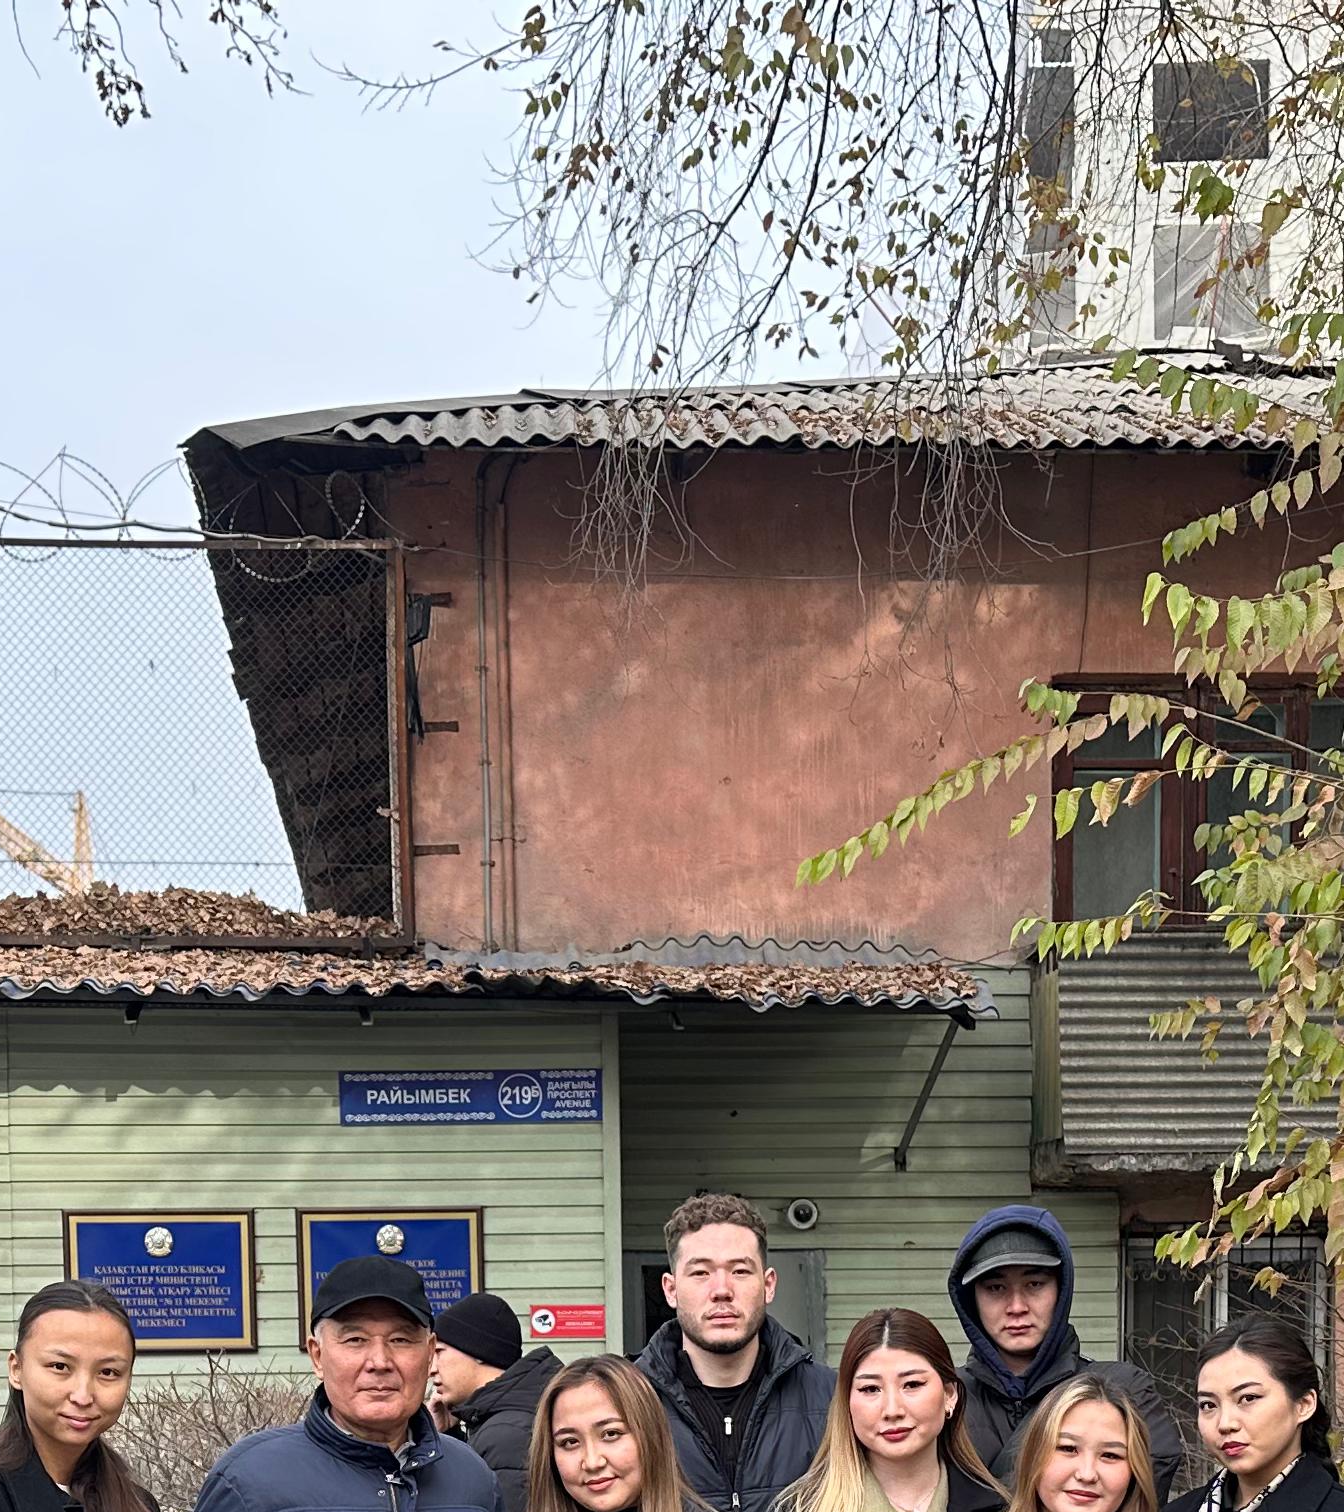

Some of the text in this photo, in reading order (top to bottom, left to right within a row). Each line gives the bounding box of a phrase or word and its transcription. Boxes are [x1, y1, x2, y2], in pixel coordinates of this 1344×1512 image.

[366, 1086, 471, 1105] РАЙЫМБЕК
[546, 1090, 597, 1099] ПРОСПЕКТ
[554, 1099, 592, 1108] AVENUE
[94, 1265, 226, 1275] ҚАЗАҚСТАН РЕСПУБЛИКАСЫ
